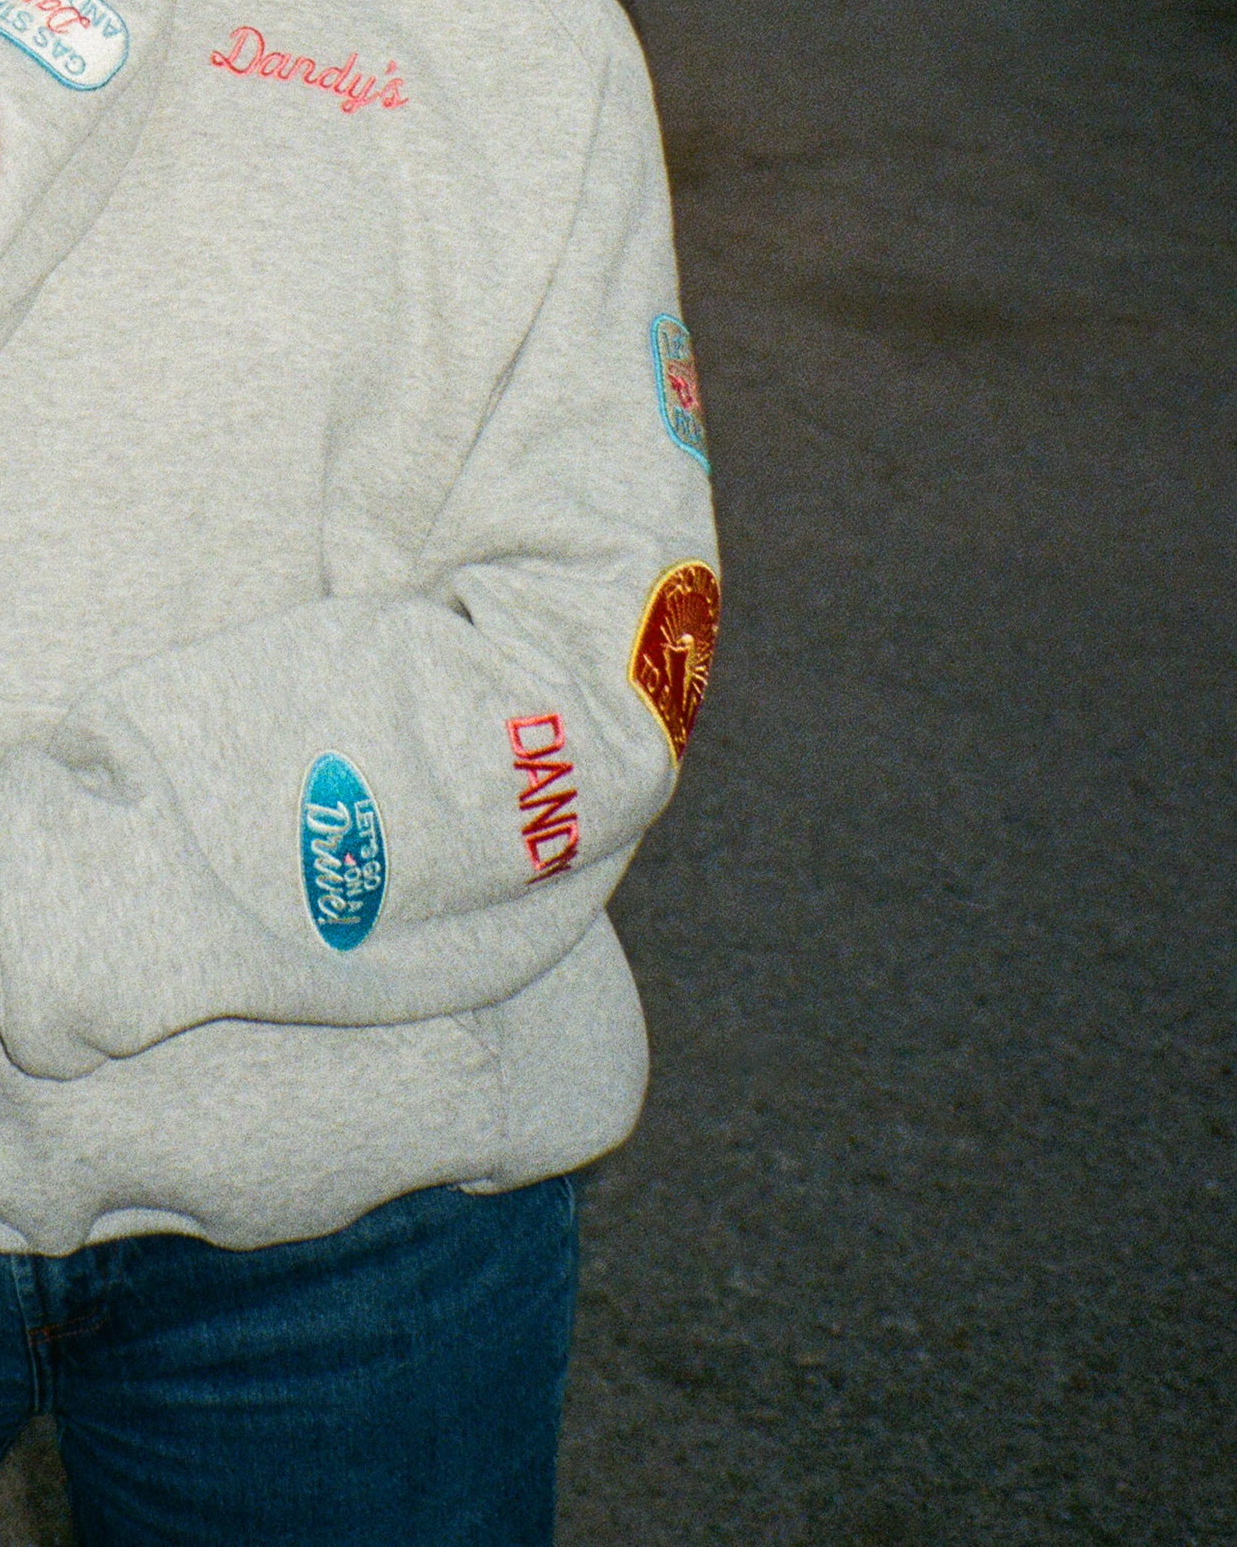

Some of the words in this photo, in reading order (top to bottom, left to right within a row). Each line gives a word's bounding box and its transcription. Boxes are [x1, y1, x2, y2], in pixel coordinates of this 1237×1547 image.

[33, 26, 86, 76] GAS
[210, 26, 409, 113] Dandy's
[306, 800, 362, 925] Drive!
[343, 866, 363, 897] ON
[363, 860, 382, 892] GO
[347, 900, 364, 913] A
